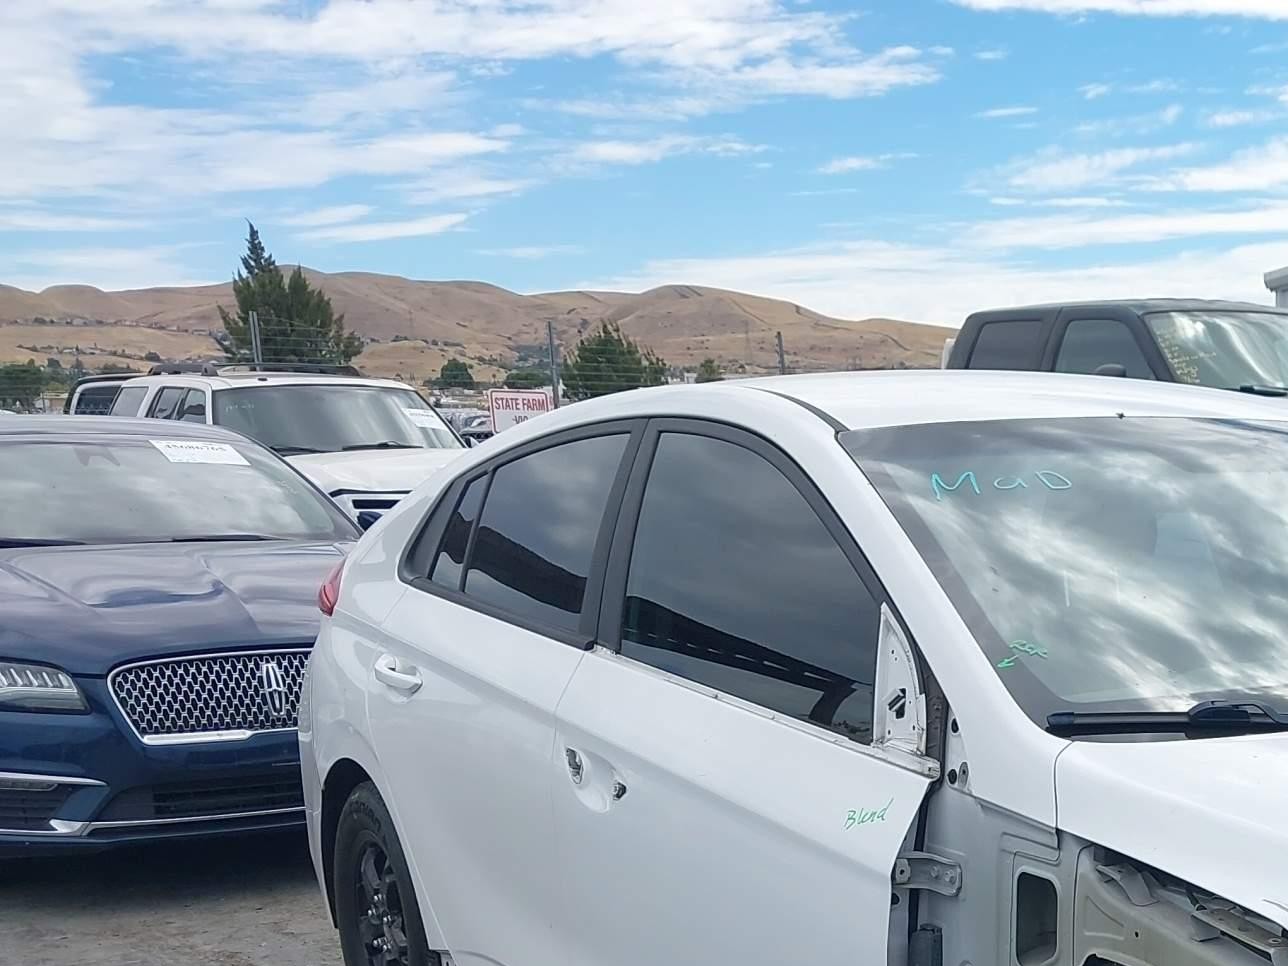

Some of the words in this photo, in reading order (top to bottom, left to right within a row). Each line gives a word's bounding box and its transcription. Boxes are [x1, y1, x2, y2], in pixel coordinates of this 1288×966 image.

[494, 397, 521, 410] STATE
[521, 398, 546, 411] FARM
[843, 797, 895, 830] Blend
